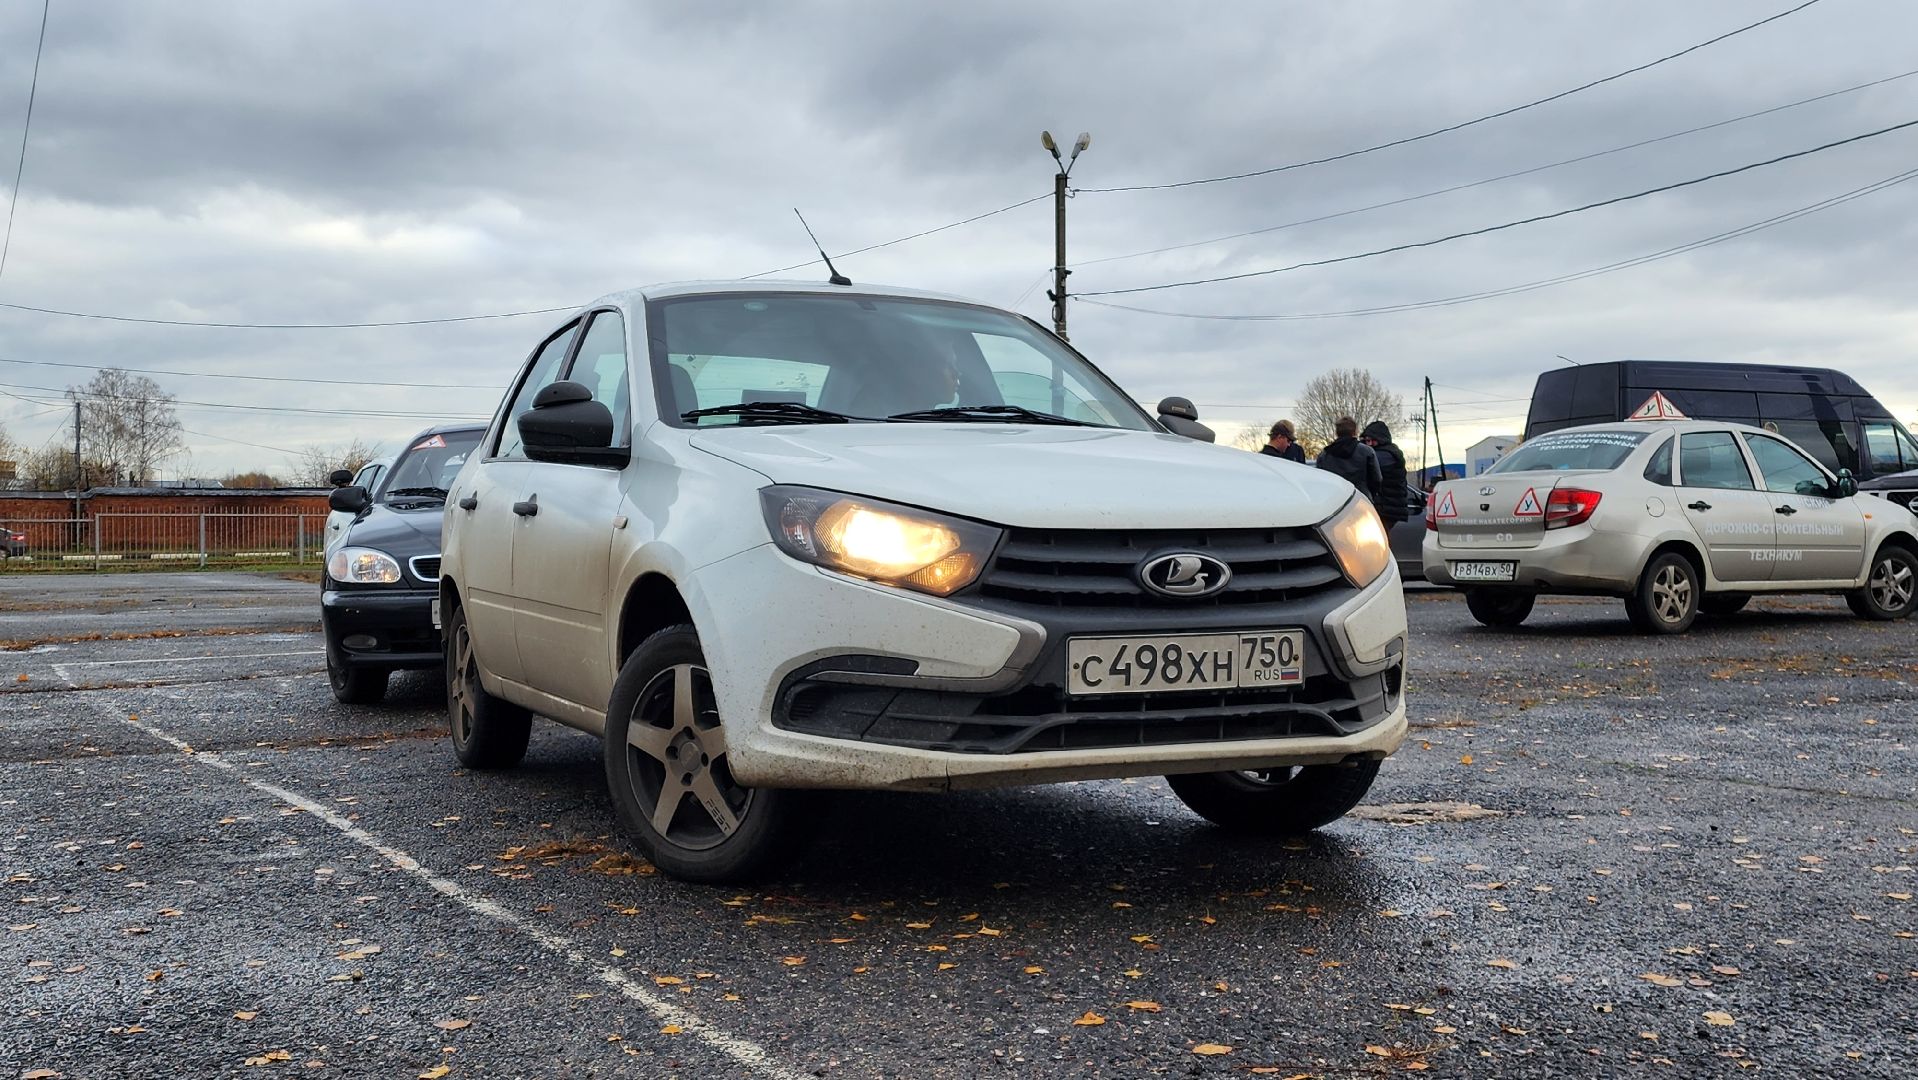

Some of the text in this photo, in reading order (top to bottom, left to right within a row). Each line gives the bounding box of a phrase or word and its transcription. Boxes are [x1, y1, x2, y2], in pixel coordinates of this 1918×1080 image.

[1704, 522, 1844, 536] ДОРОЖНО-СТРОИТЕЛЬНЫЙ
[1750, 550, 1802, 561] ТЕХНИКУМ
[1500, 563, 1511, 573] 50
[1081, 636, 1295, 687] С498ХН 750
[1254, 669, 1280, 681] RUS
